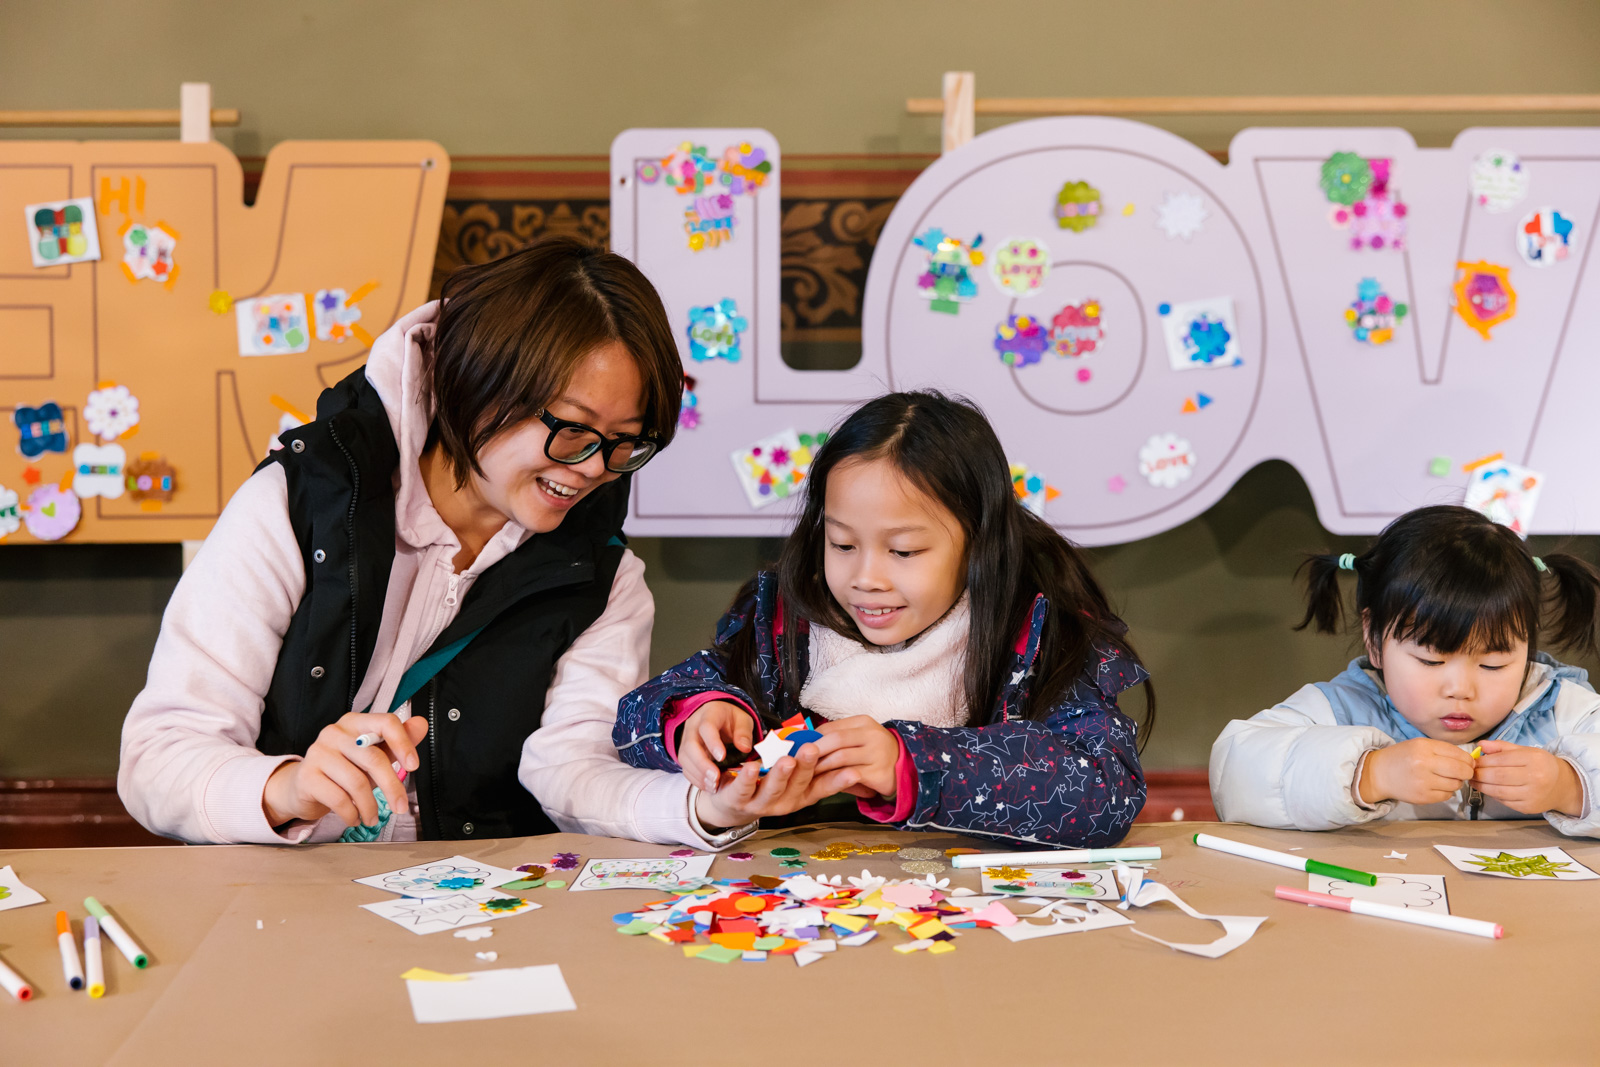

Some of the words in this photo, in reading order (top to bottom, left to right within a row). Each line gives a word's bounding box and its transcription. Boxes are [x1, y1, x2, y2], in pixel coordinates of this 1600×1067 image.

[99, 175, 146, 216] HI
[1055, 326, 1098, 341] LOVE
[1146, 453, 1189, 473] LOVE
